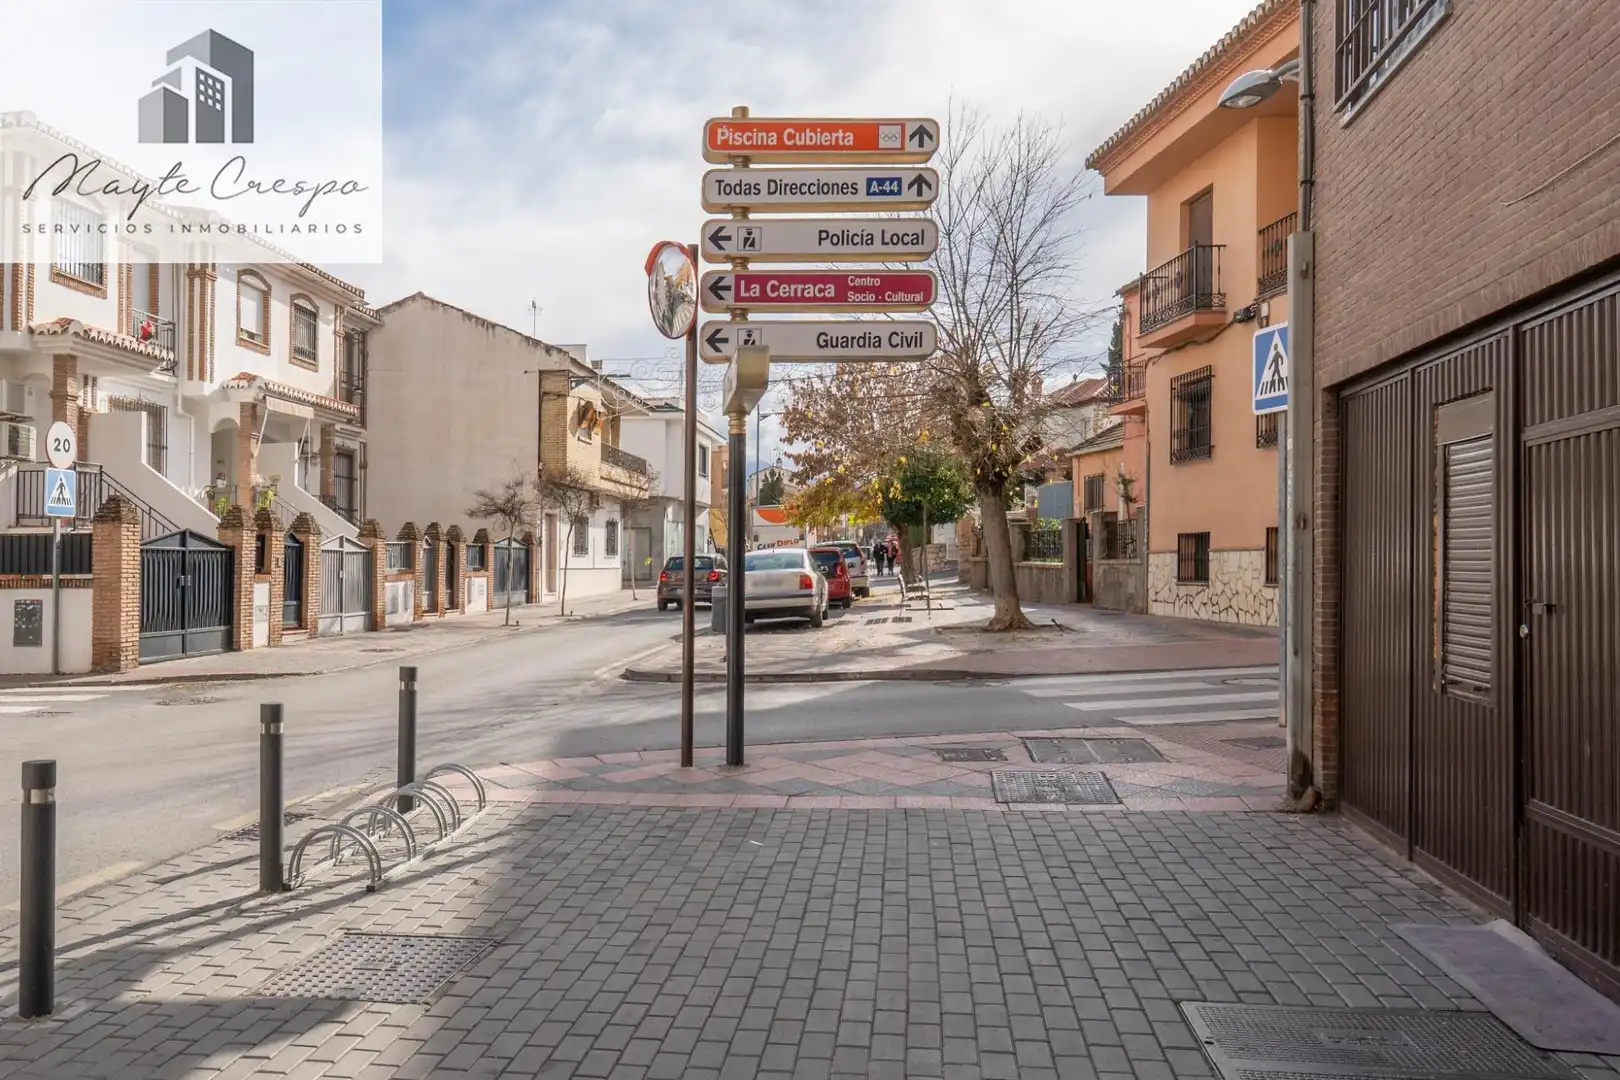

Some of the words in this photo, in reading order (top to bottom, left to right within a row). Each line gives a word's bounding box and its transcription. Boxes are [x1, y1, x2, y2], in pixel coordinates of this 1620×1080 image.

[717, 127, 777, 146] Piscina
[783, 128, 854, 146] Cubierta
[715, 179, 761, 196] Todas
[767, 178, 858, 195] Direcciones
[869, 180, 899, 193] A-44
[818, 228, 874, 247] Policía
[881, 229, 924, 246] Local
[740, 280, 760, 297] La
[766, 280, 835, 298] Cerraca
[848, 276, 881, 287] Centro
[847, 291, 876, 302] Socio
[885, 291, 924, 302] Cultural
[816, 332, 882, 349] Guardia
[888, 331, 923, 349] Civil
[54, 437, 71, 453] 20
